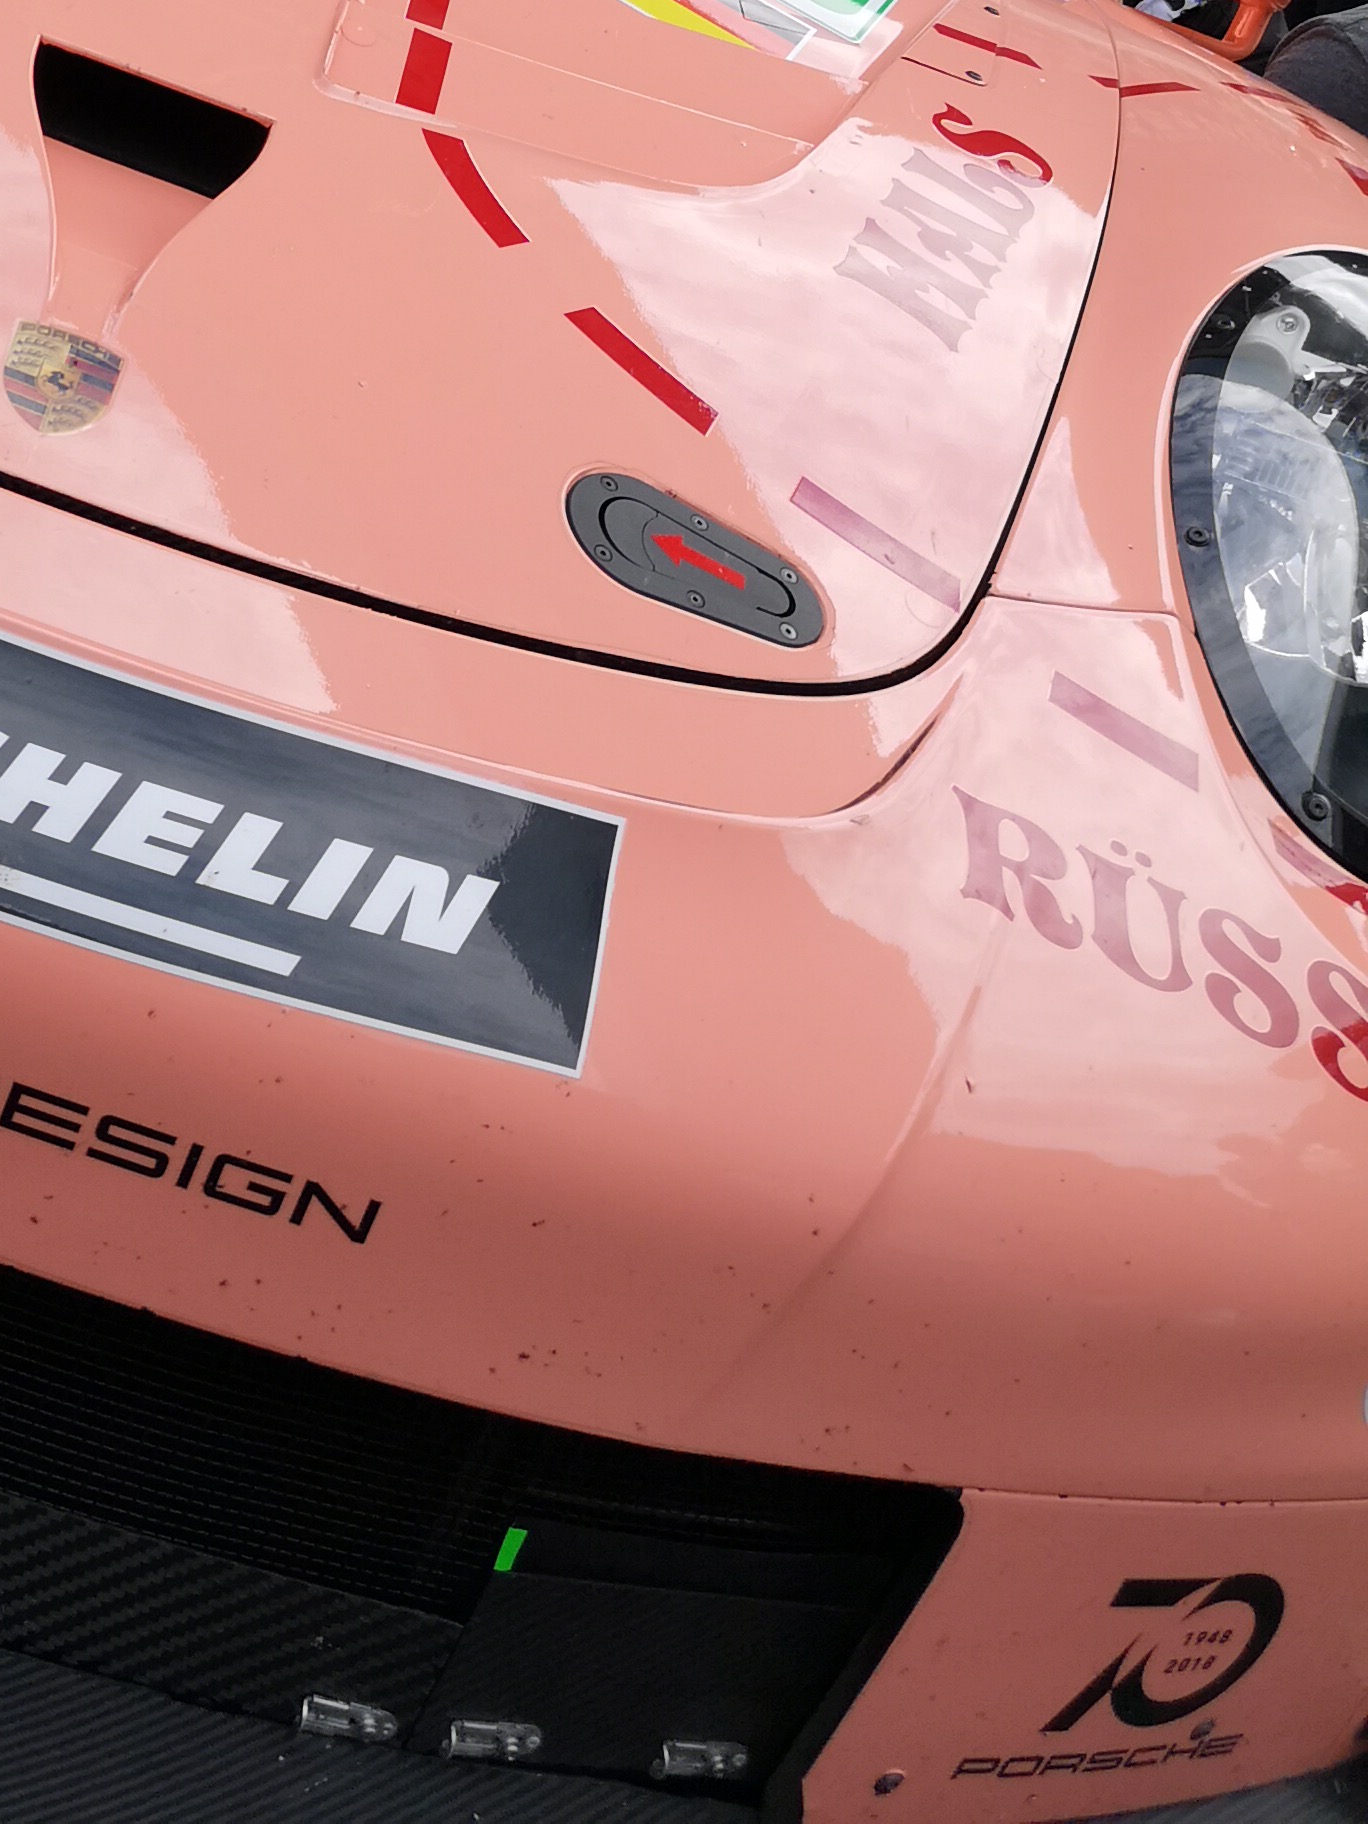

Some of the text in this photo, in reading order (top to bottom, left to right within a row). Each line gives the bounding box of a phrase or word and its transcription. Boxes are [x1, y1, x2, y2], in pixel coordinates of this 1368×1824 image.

[834, 101, 1053, 353] HALS
[1039, 1573, 1285, 1732] 70
[1182, 1628, 1234, 1647] 1948
[1163, 1654, 1217, 1675] 2018
[950, 1733, 1244, 1780] PORSCHE
